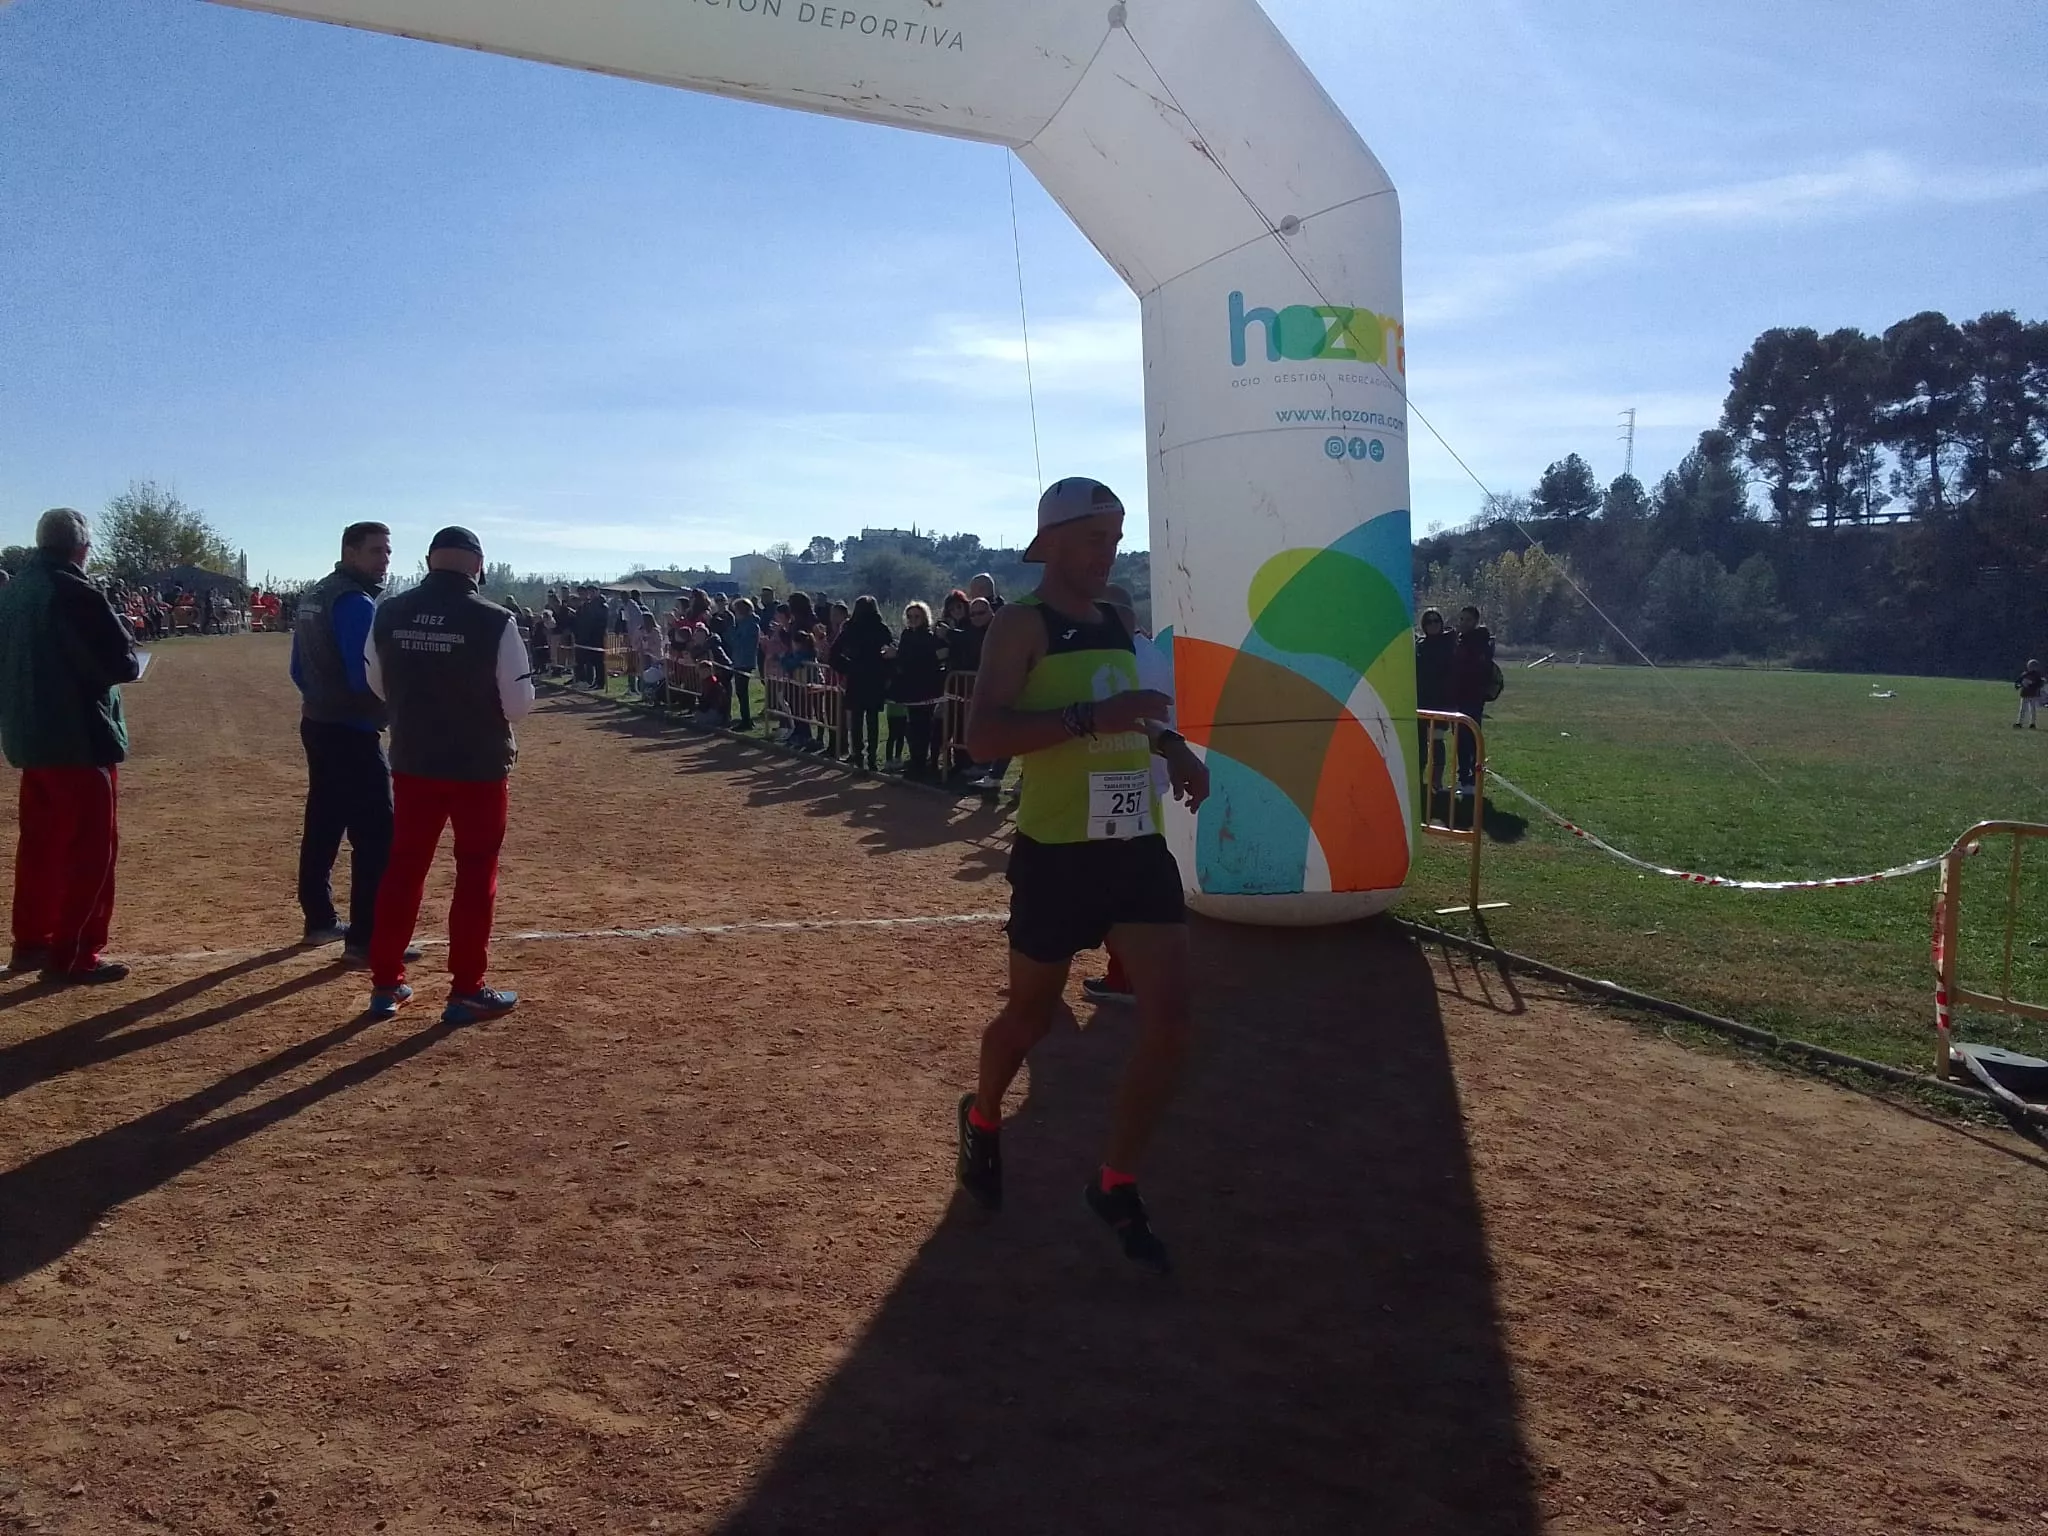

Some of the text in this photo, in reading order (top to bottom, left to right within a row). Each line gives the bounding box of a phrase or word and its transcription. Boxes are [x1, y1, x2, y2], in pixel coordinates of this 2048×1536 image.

[798, 2, 964, 51] DEPORTIVA
[1232, 377, 1261, 388] OCIO
[1275, 405, 1404, 432] www.hozona.com
[412, 614, 445, 625] JUEZ
[411, 640, 452, 653] ATLETISMO
[1111, 789, 1142, 815] 257
